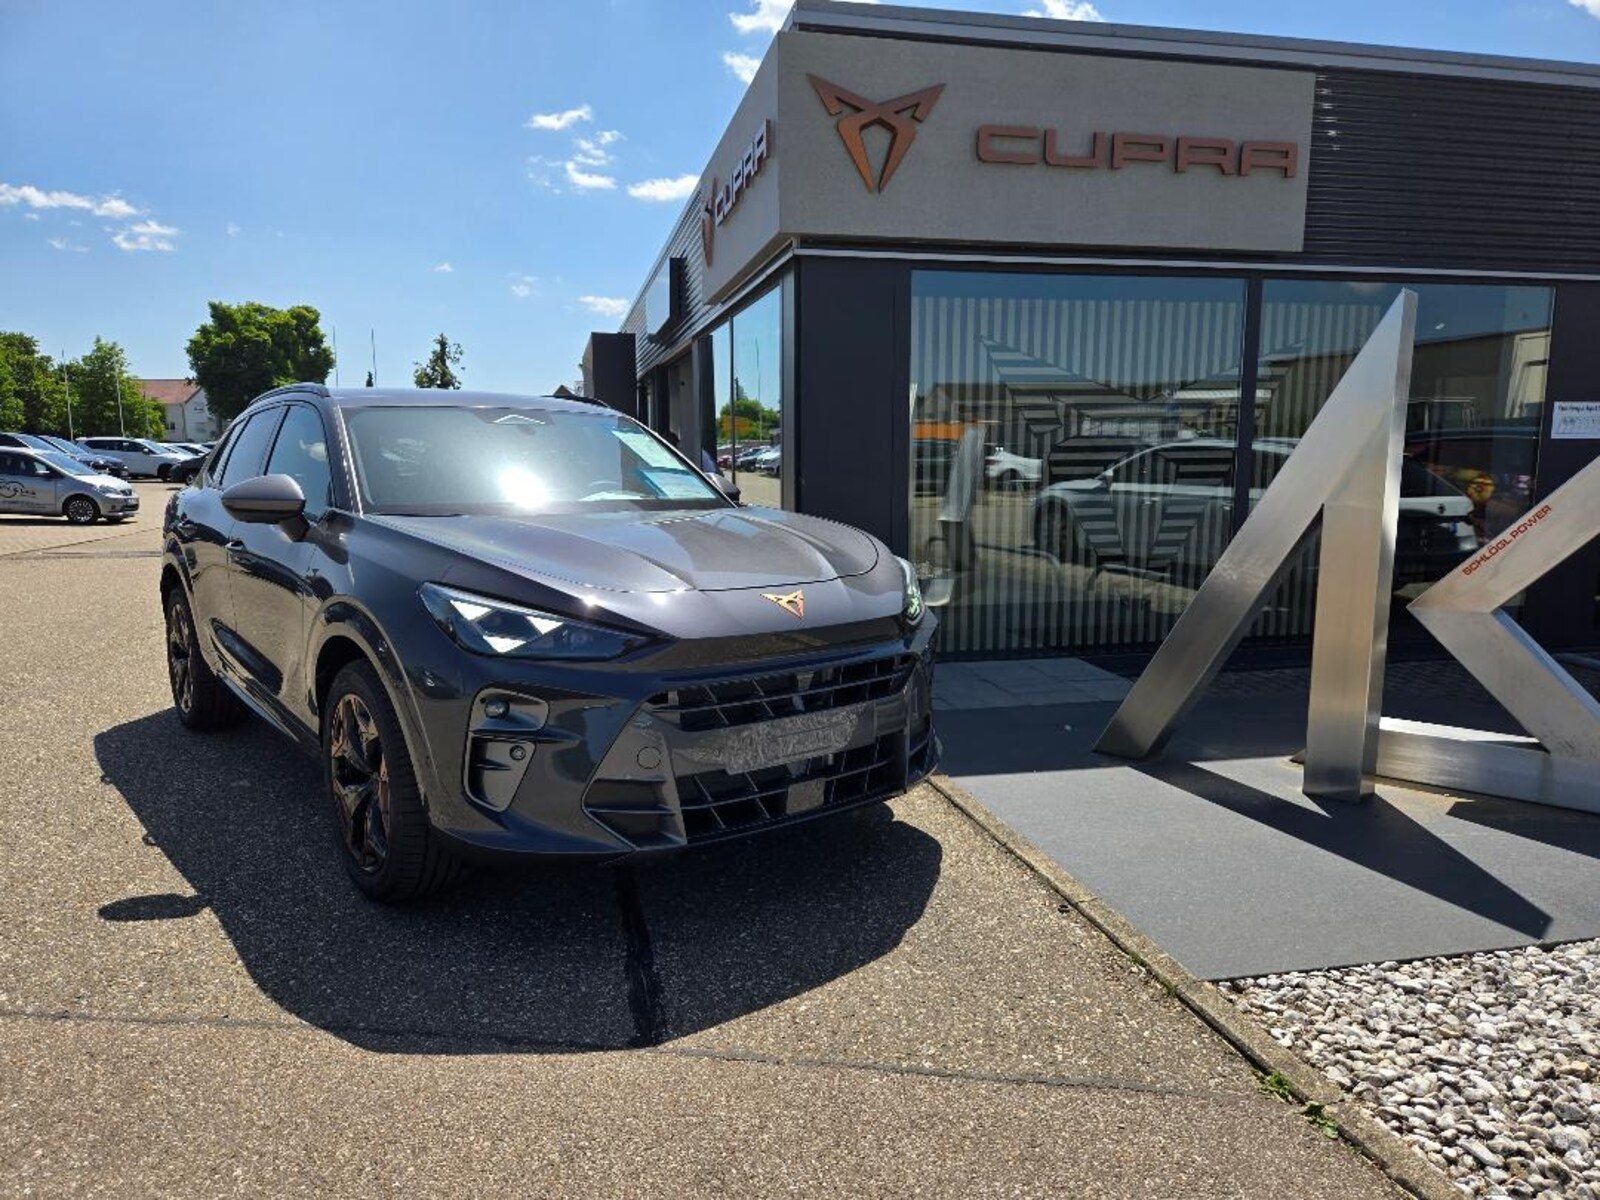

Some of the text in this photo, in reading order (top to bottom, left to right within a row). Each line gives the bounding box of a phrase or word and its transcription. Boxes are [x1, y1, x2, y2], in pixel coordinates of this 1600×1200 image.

[714, 118, 771, 227] CUPRA
[976, 124, 1298, 179] CUPRA
[1462, 504, 1552, 576] SCHLÖGL POWER
